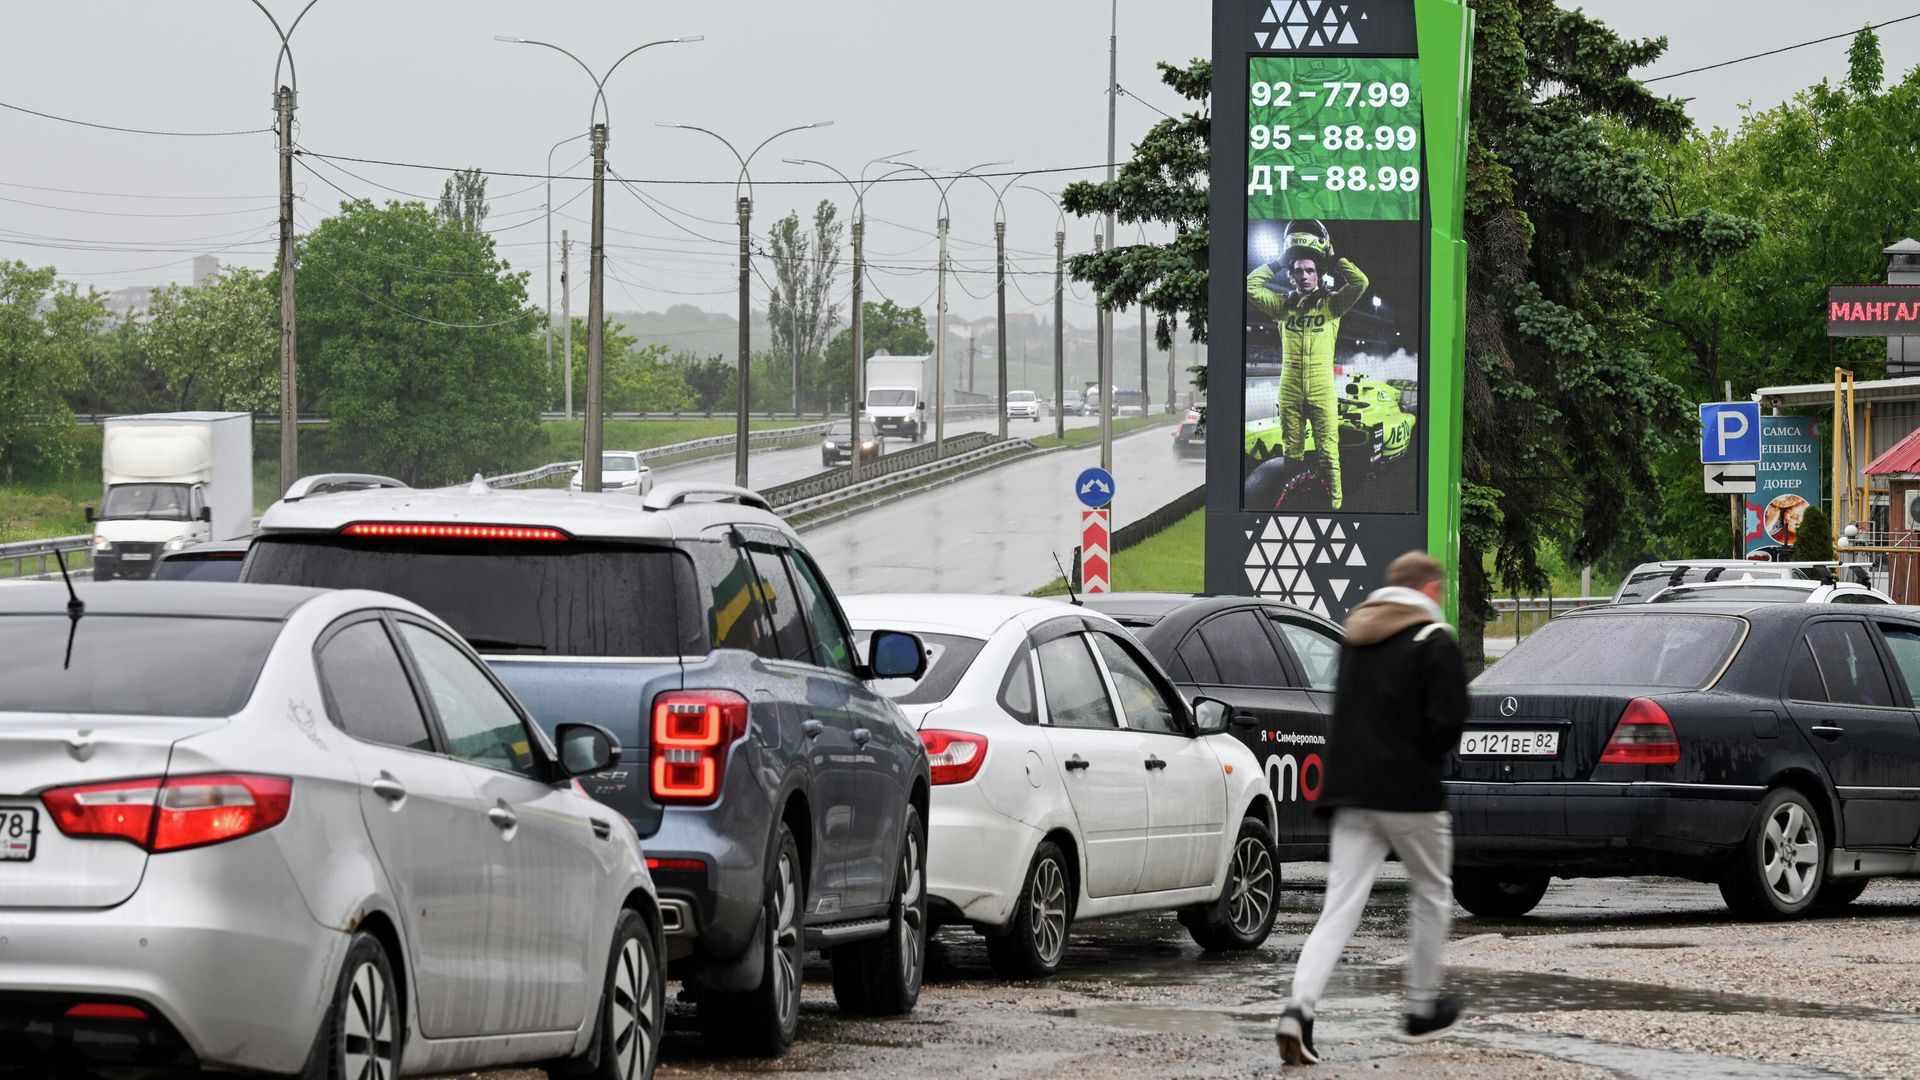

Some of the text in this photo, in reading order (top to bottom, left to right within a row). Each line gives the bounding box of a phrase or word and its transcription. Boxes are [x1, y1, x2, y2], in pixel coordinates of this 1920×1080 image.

[1251, 82, 1292, 107] 92
[1323, 82, 1410, 107] 77.99
[1250, 125, 1291, 150] 95
[1323, 125, 1417, 151] 88.99
[1248, 165, 1295, 195] ДТ
[1325, 166, 1420, 192] 88.99
[1718, 411, 1749, 456] P
[1763, 427, 1801, 436] САМСА
[1761, 444, 1812, 454] ЕПЕШКИ
[1758, 462, 1808, 471] ШАУРМА
[1763, 480, 1802, 490] ДОНЕР
[1261, 730, 1326, 746] Я Симферополь
[1536, 733, 1553, 748] 82
